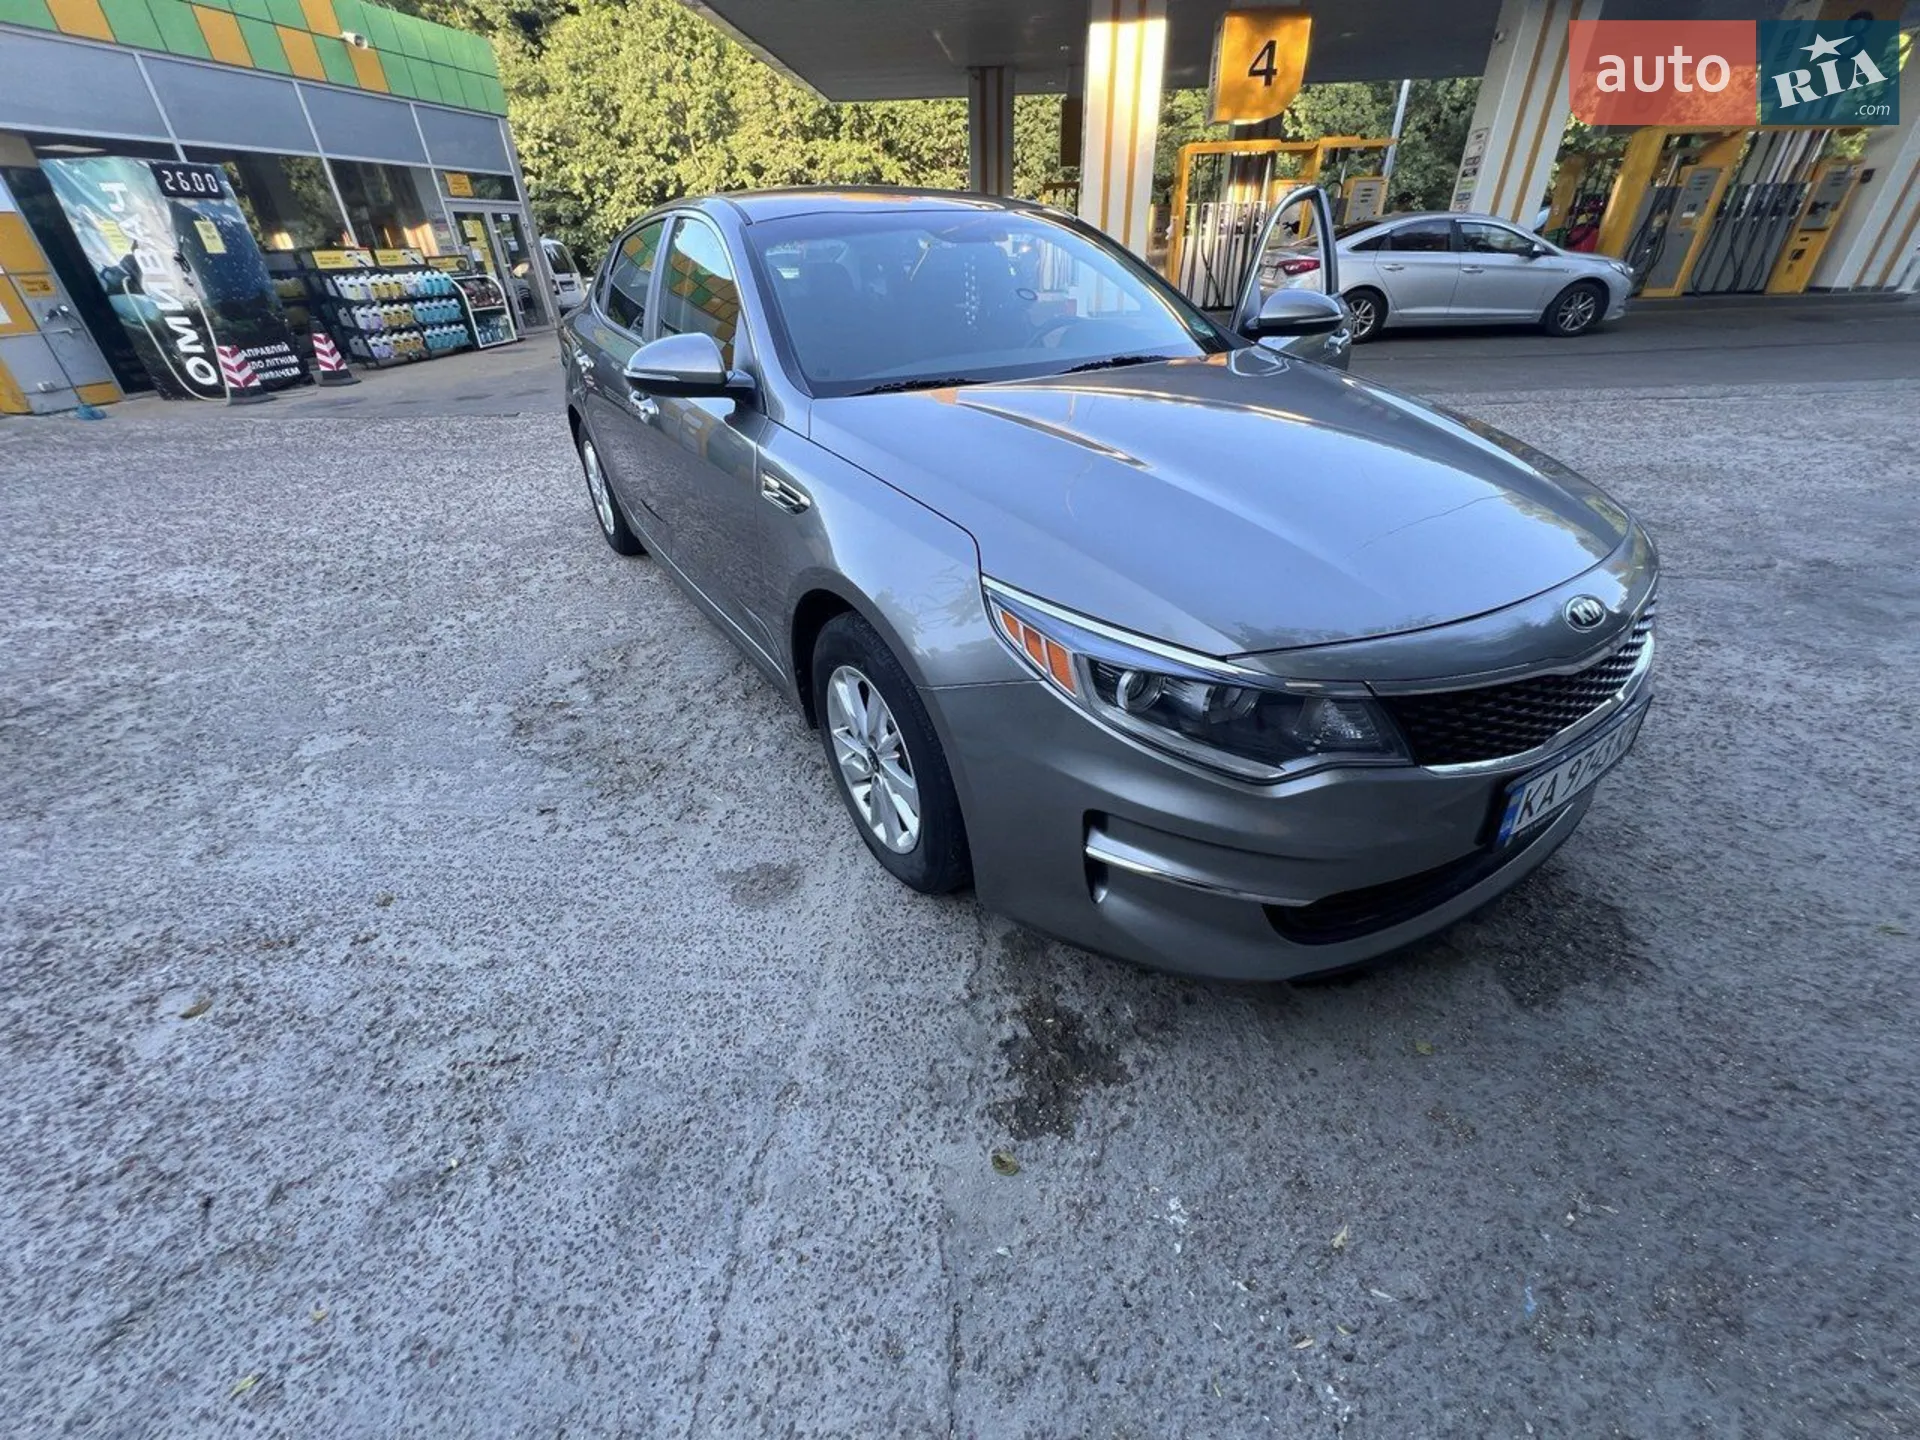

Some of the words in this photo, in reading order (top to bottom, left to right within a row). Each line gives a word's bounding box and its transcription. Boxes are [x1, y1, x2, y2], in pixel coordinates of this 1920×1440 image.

[1248, 39, 1278, 86] 4
[161, 170, 219, 193] 26.00
[99, 182, 219, 386] ОМИВАЧ
[240, 341, 291, 358] АПРАВЛЯЙ
[1517, 772, 1559, 825] KA
